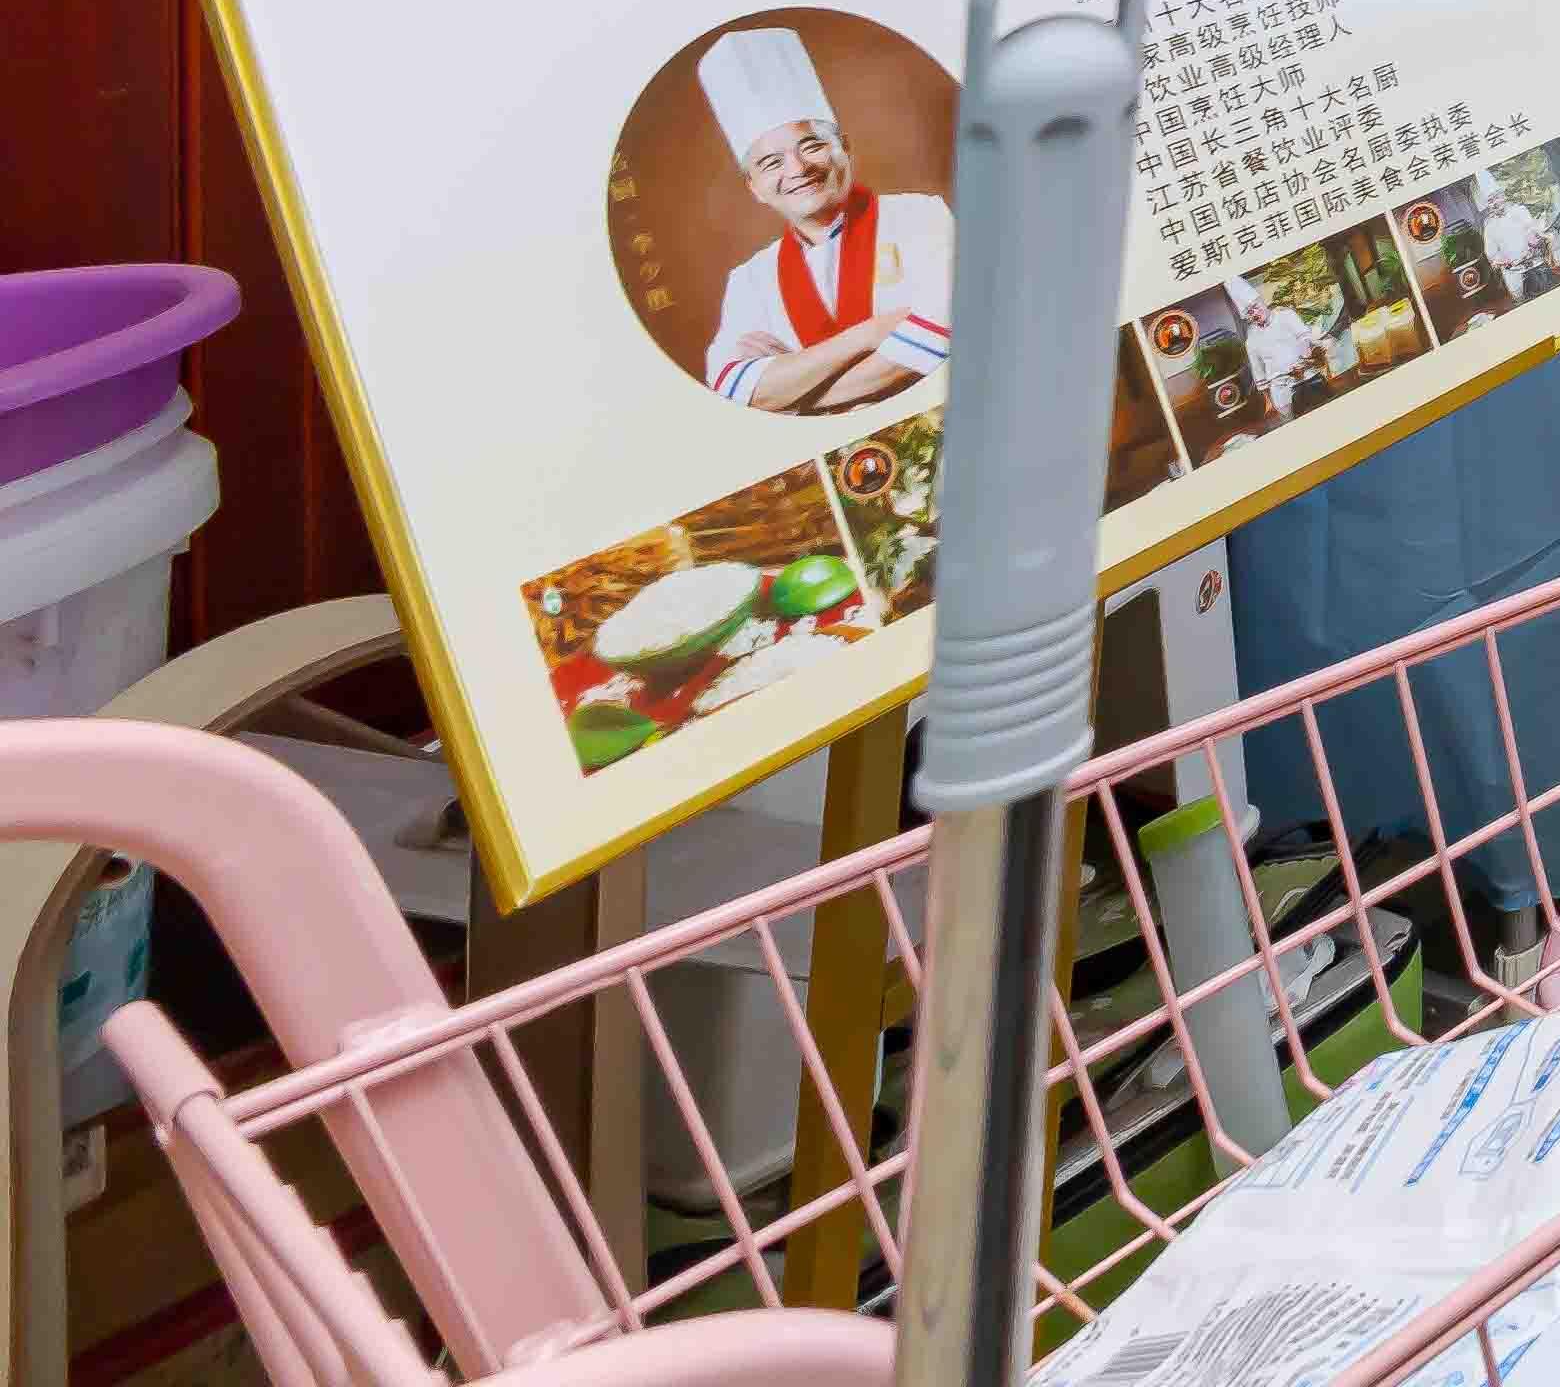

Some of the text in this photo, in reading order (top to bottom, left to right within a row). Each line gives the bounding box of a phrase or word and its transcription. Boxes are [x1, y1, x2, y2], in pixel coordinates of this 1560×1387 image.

[1137, 61, 1400, 180] 中国长三角十大名厨
[1146, 104, 1385, 215] 江苏省餐饮业评委
[1160, 101, 1474, 245] 中国饭店协会名厨委执委
[1170, 112, 1533, 282] 爱斯克菲国际美食会荣誉会长
